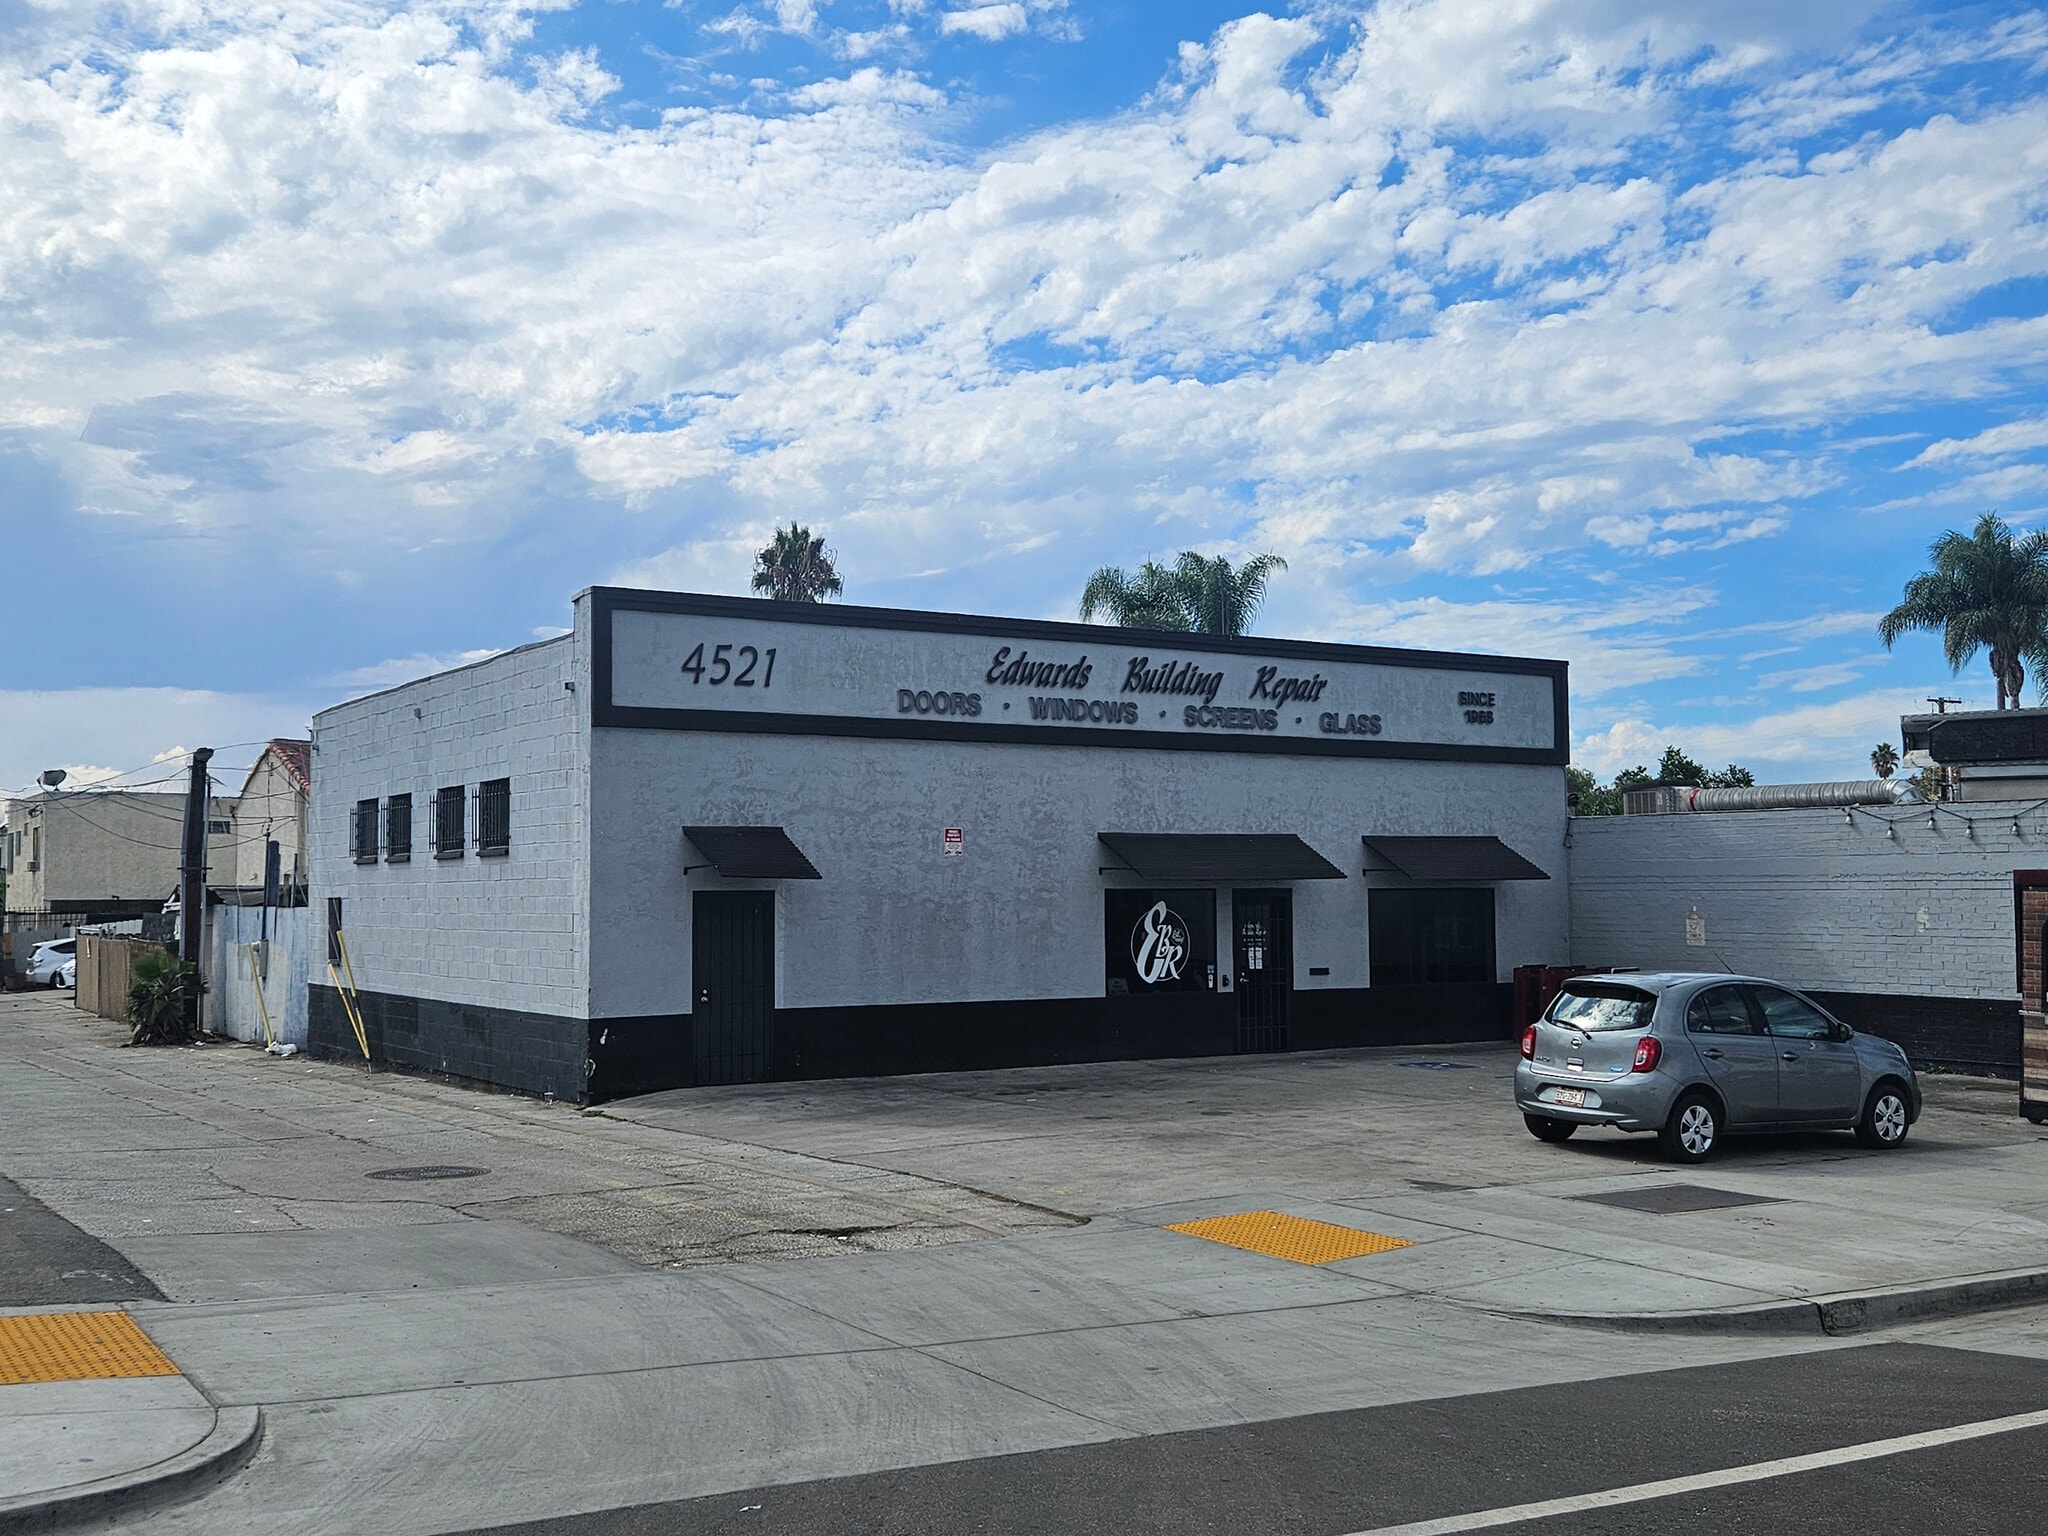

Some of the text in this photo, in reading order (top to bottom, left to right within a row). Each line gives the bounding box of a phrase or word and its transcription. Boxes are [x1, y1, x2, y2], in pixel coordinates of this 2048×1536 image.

[681, 642, 777, 688] 4521
[985, 646, 1328, 709] Edwards Building Repair
[897, 689, 1382, 736] DOORS WINDOWS SCREENS GLASS
[1458, 691, 1496, 707] SINCE
